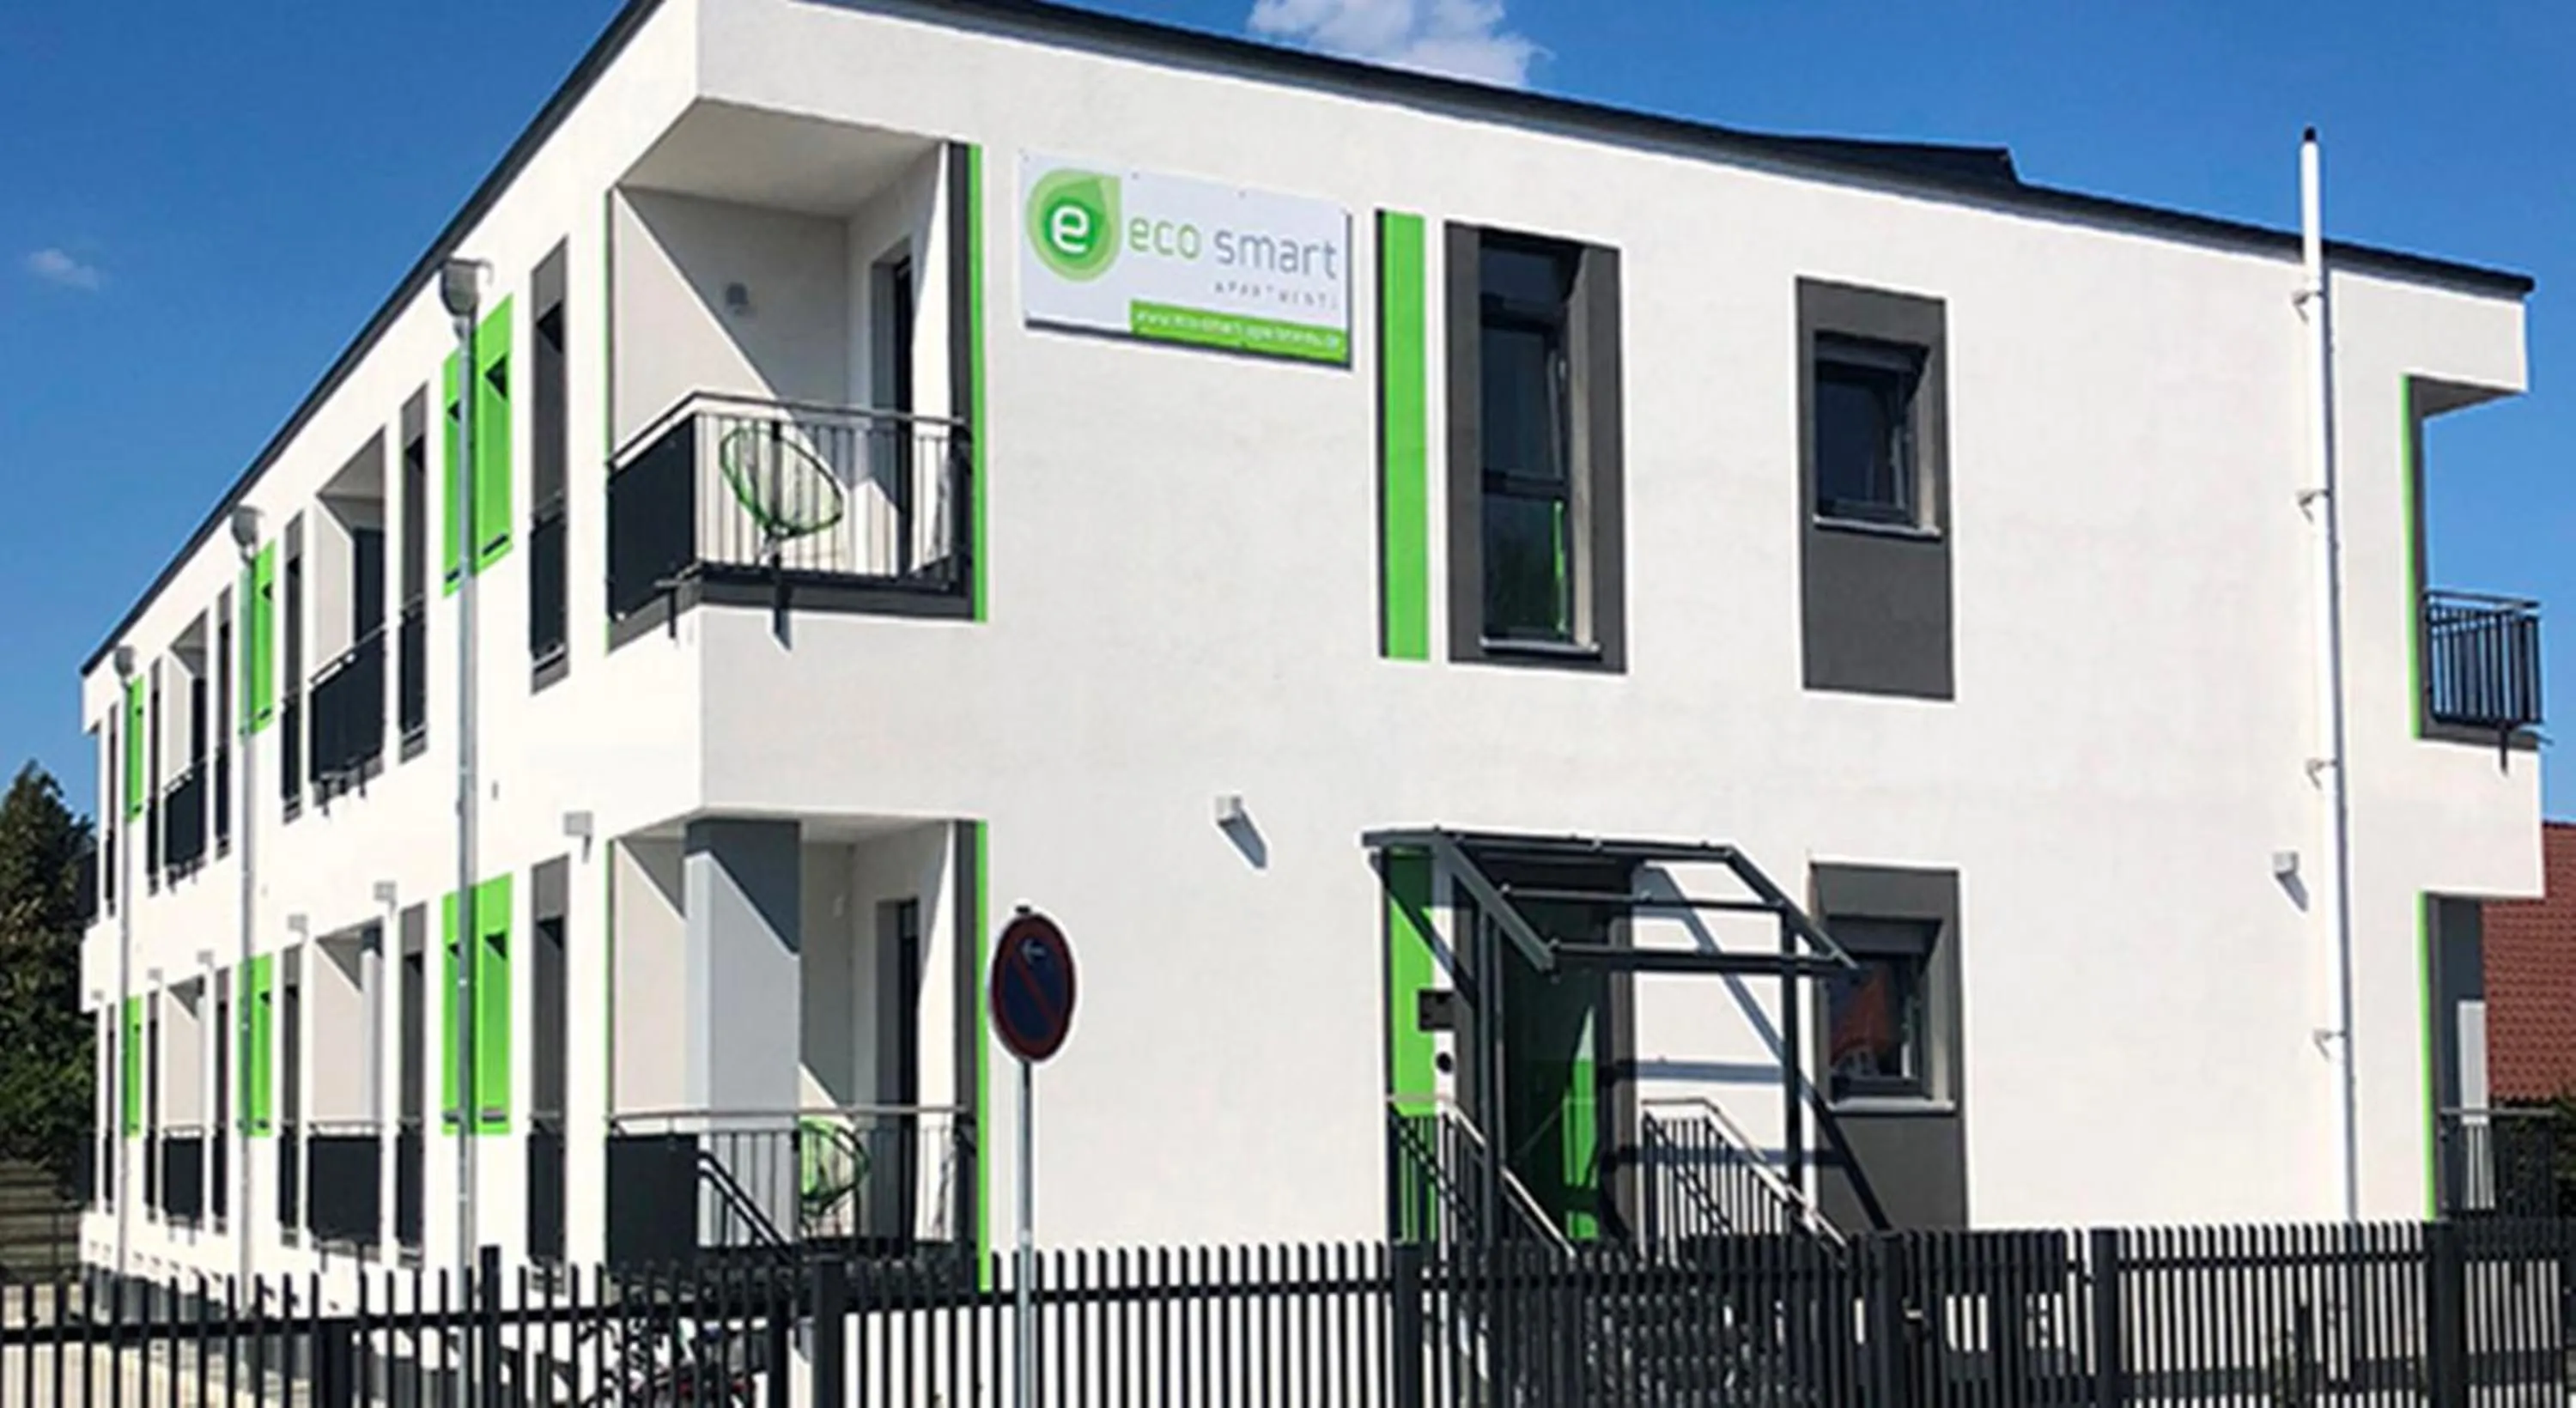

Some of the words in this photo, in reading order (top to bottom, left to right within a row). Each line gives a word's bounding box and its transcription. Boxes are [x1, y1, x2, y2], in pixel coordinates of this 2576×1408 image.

[1053, 204, 1090, 253] e
[1128, 216, 1201, 260] eco
[1213, 228, 1338, 280] smart
